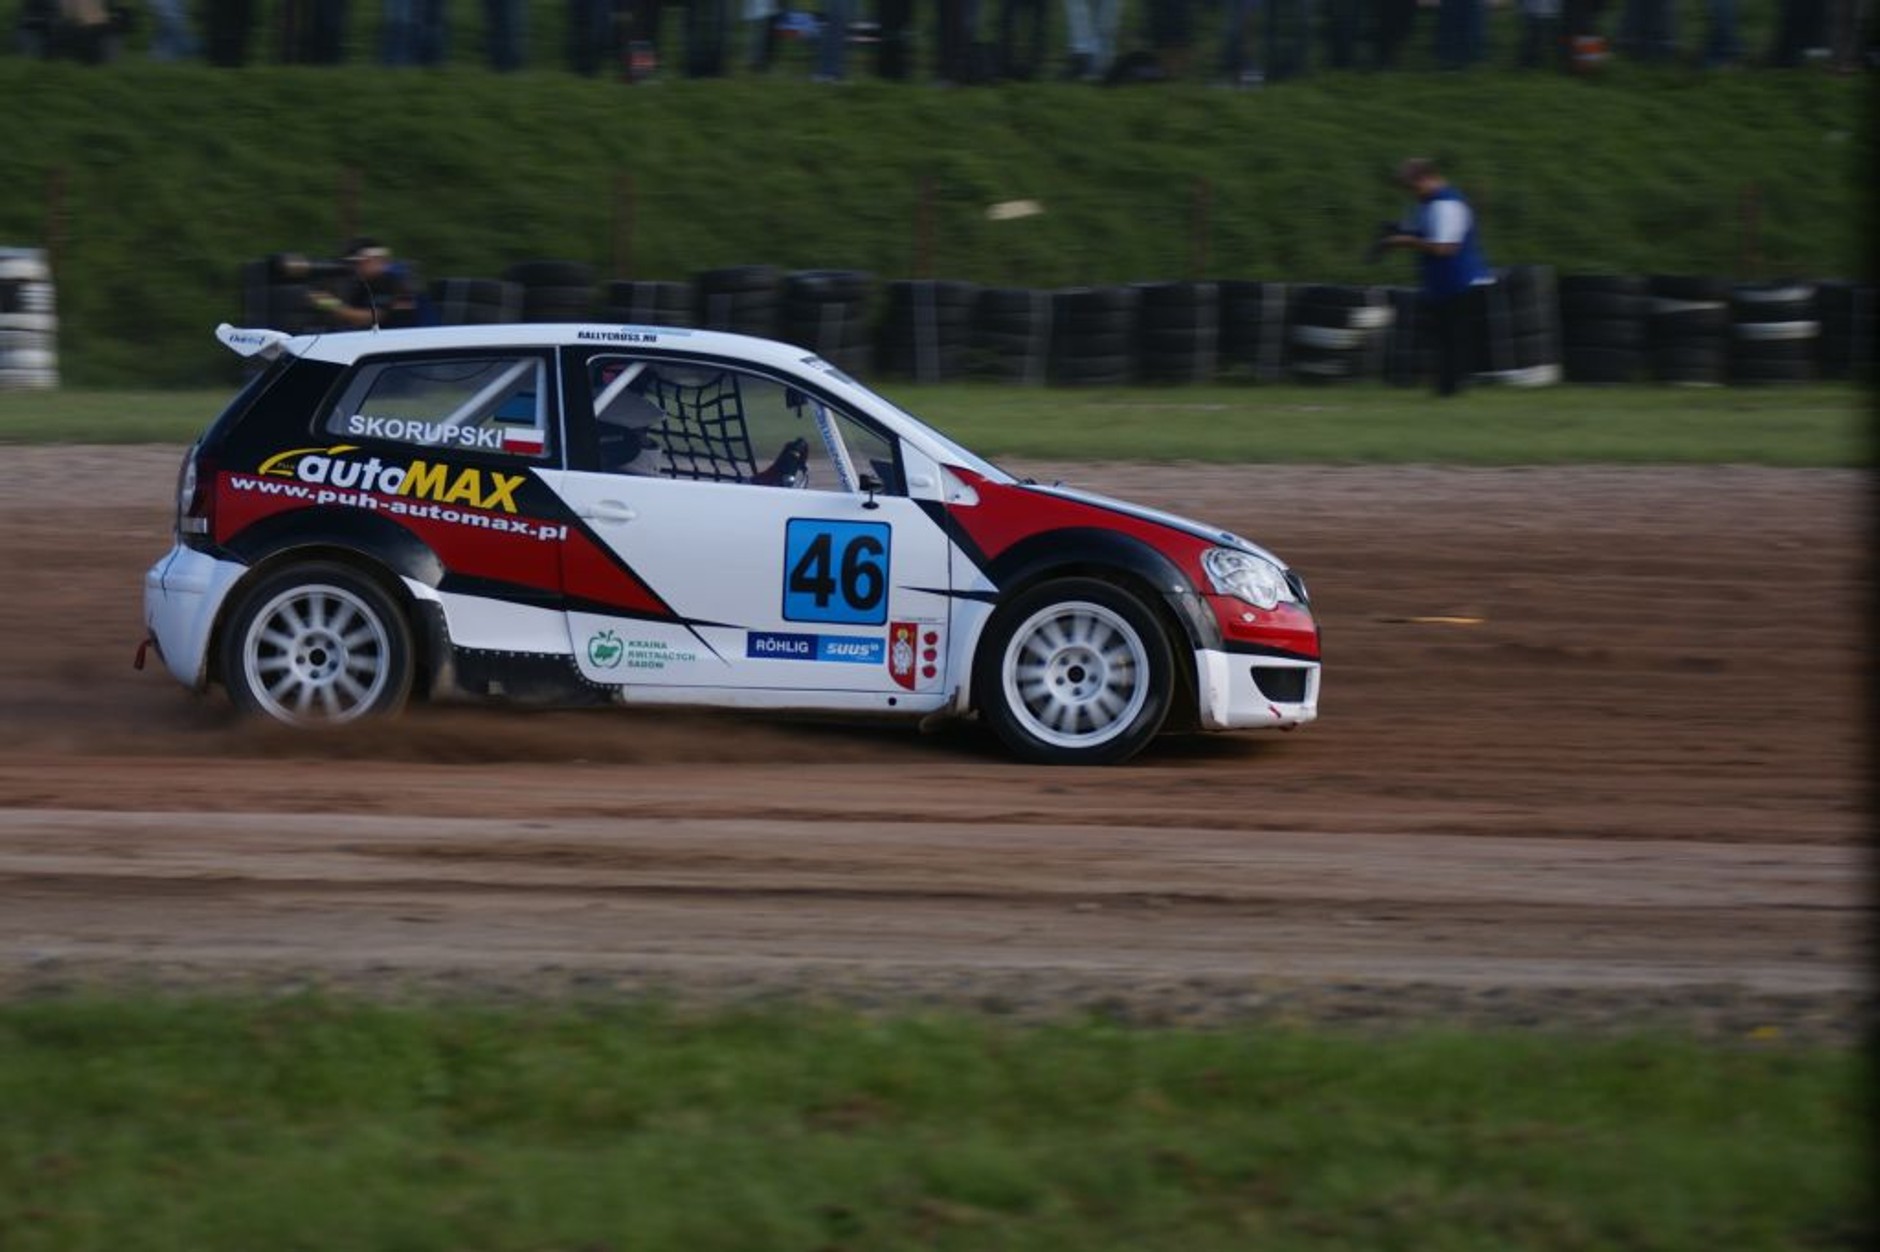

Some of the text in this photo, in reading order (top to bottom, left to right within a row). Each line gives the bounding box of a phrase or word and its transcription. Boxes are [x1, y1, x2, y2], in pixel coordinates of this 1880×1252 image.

[349, 415, 502, 448] SKORUPSKI
[230, 476, 568, 541] www.puh-automax.pl
[790, 533, 884, 611] 46
